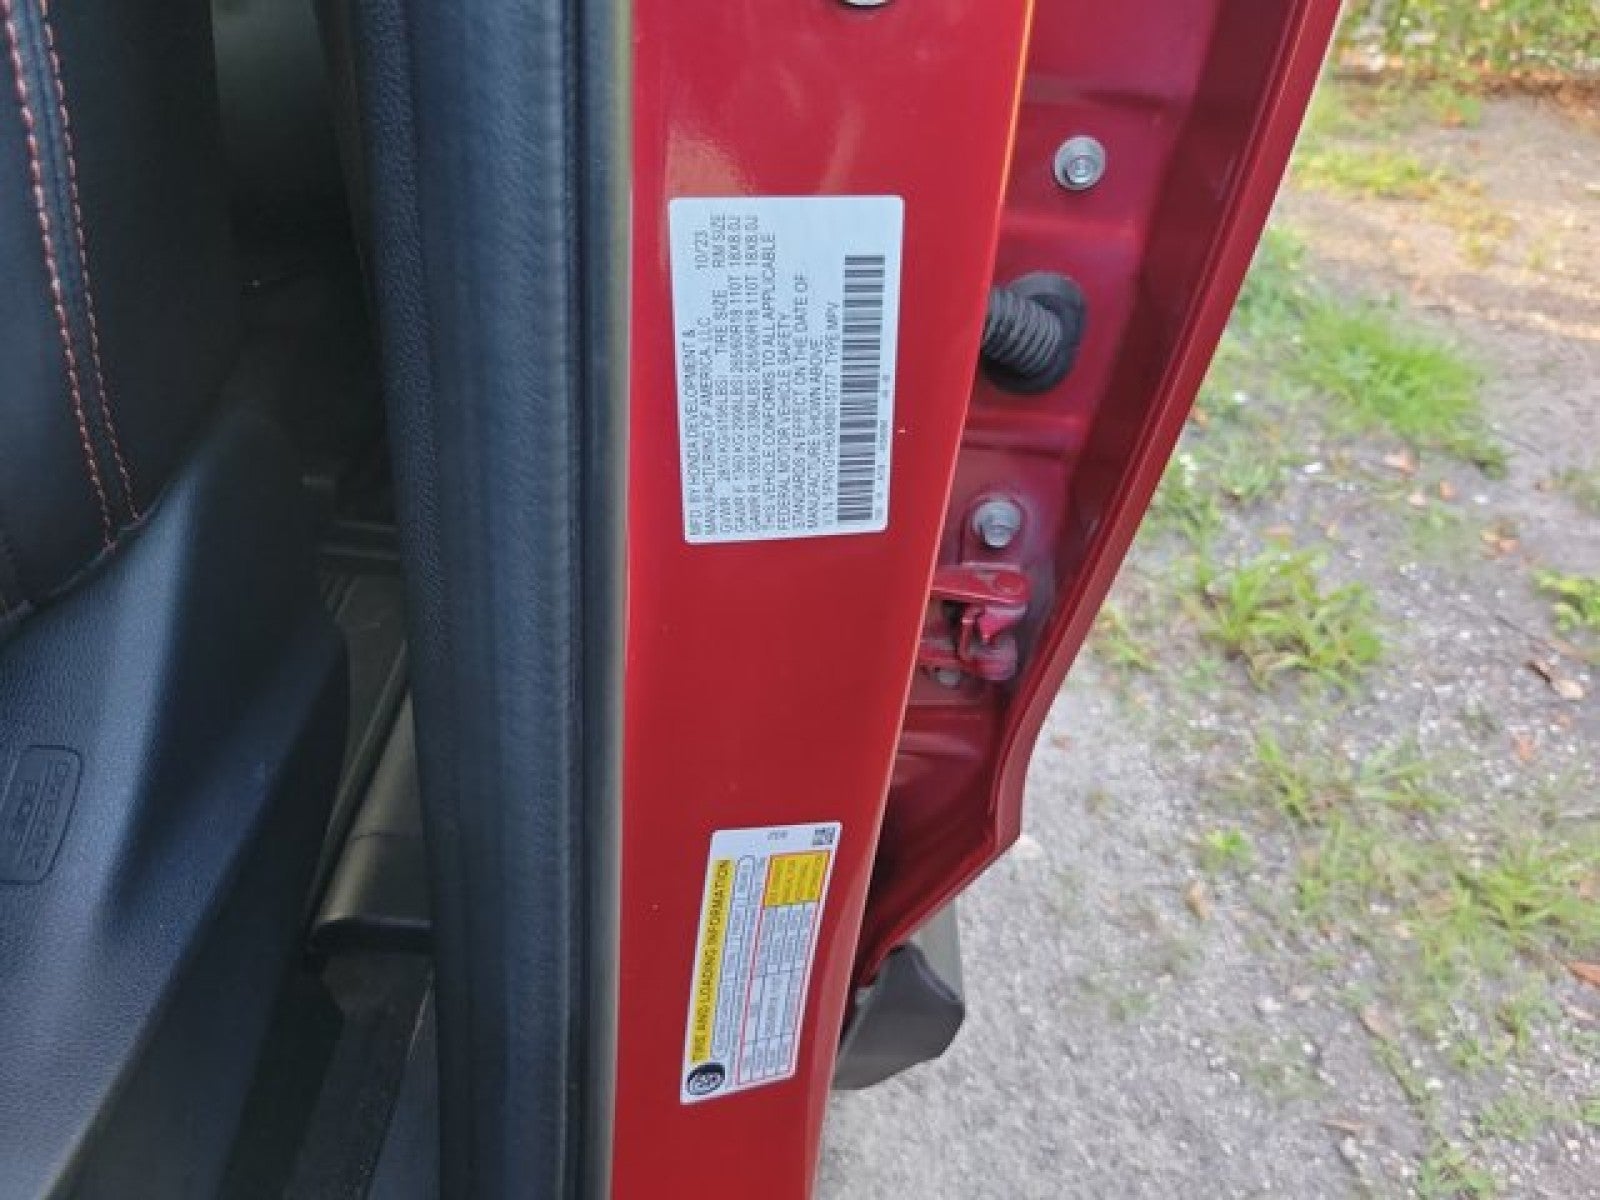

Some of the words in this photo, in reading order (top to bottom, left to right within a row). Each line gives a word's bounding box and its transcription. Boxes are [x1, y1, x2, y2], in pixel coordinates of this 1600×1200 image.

[710, 213, 725, 241] SIZE
[694, 229, 709, 269] 10/23
[711, 244, 726, 268] RIM
[728, 273, 743, 304] 110T
[744, 273, 759, 303] 110T
[760, 232, 775, 320] APPLICABLE
[793, 273, 808, 293] OF
[713, 289, 727, 320] SIZE
[792, 296, 807, 332] DATE
[697, 316, 711, 343] LLC
[714, 324, 728, 355] TIRE
[760, 321, 775, 346] ALL
[777, 312, 791, 365] SAFETY
[792, 335, 807, 361] THE
[761, 349, 775, 366] TO
[792, 364, 806, 386] ON
[682, 340, 698, 438] DEVELOPMENT
[777, 368, 791, 425] VEHICLE
[700, 410, 714, 429] OF
[761, 371, 775, 446] CONFORMS
[792, 387, 806, 438] EFFECT
[807, 386, 822, 436] SHOWN
[686, 439, 700, 485] HONDA
[777, 426, 790, 473] MOTOR
[792, 440, 806, 452] IN
[688, 486, 700, 502] BY
[701, 429, 717, 535] MANUFACTURING
[761, 449, 775, 503] VEHICLE
[791, 456, 805, 529] STANDARDS
[806, 438, 821, 528] MANUFACTURE
[762, 504, 775, 530] THIS
[777, 477, 790, 530] FEDERAL
[705, 859, 730, 946] INFORMATION
[698, 948, 718, 1002] LOADING
